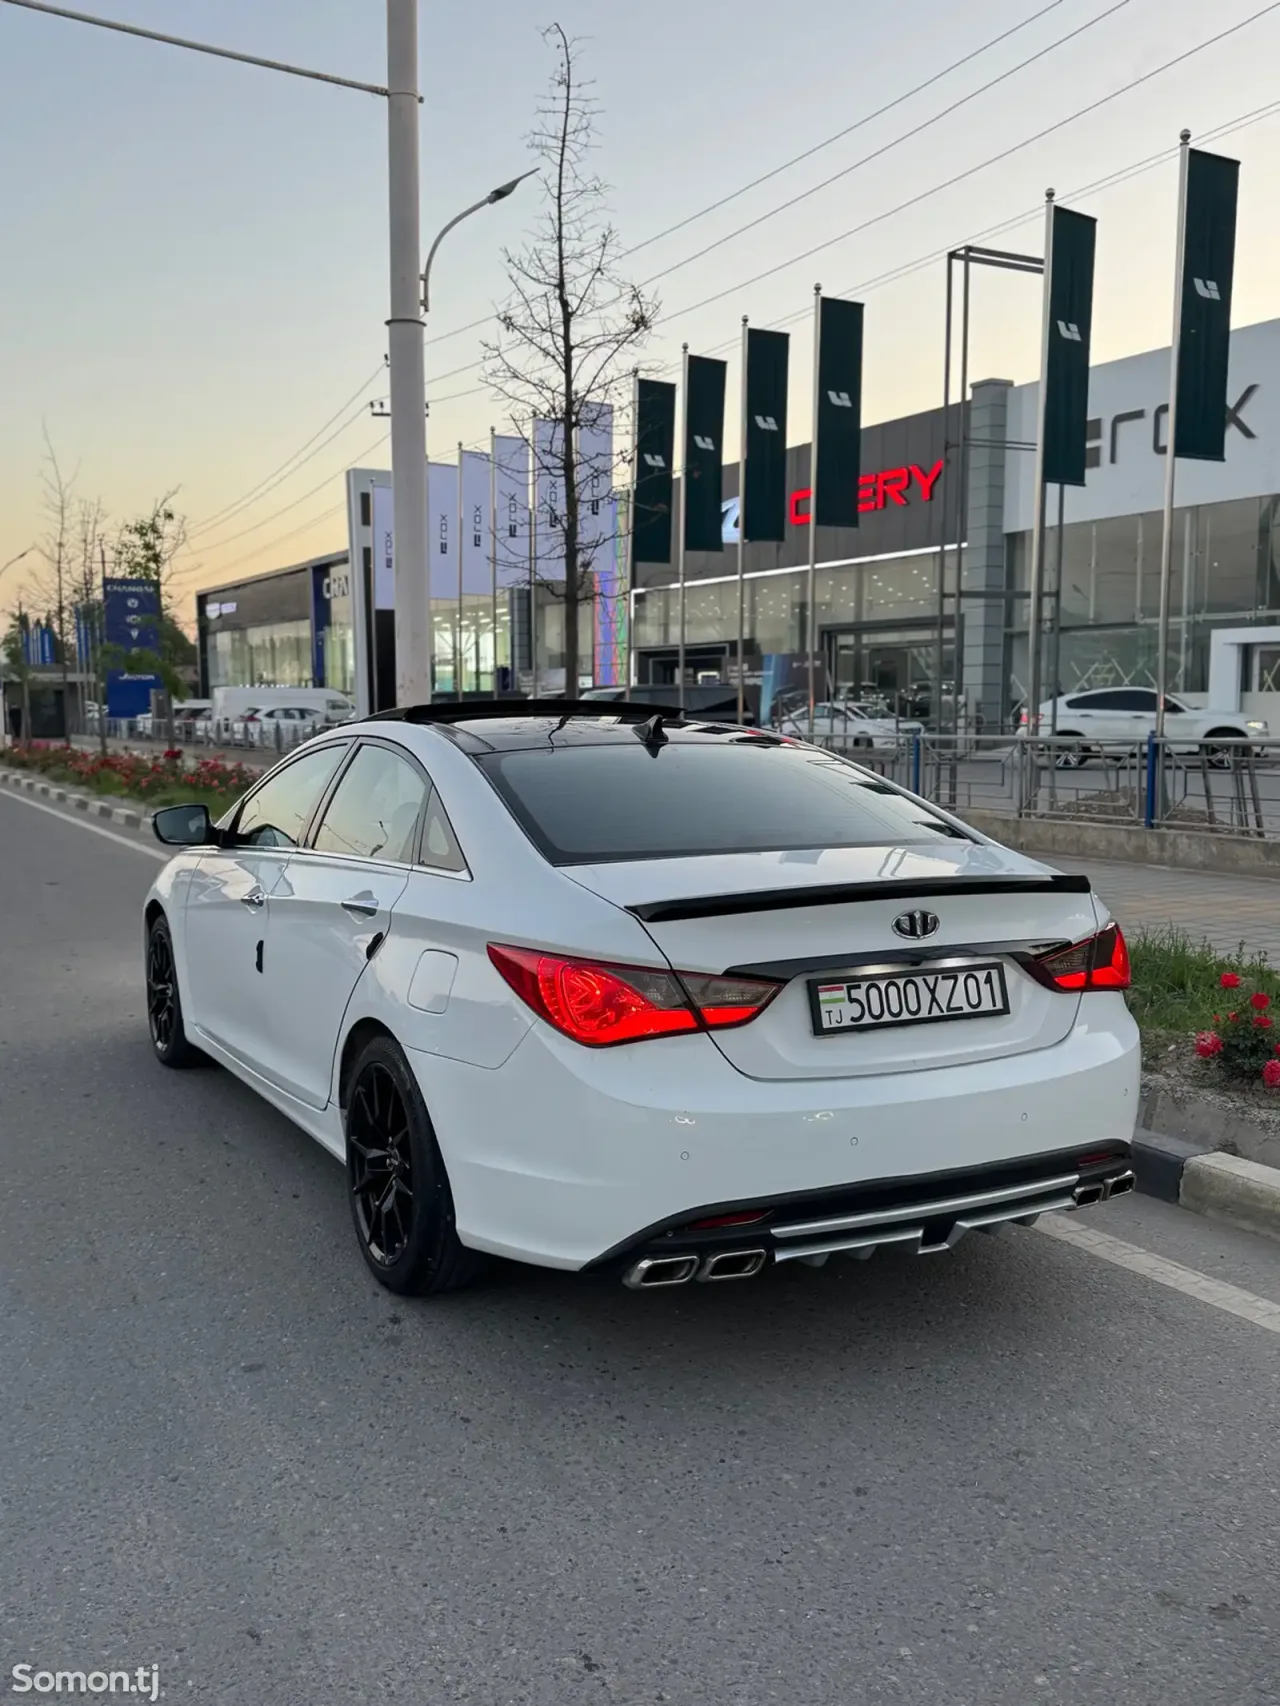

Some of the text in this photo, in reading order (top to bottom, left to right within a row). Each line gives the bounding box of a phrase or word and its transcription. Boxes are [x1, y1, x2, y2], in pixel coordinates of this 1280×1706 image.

[789, 459, 944, 525] CERY
[825, 971, 997, 1026] TJ 5000XZ01
